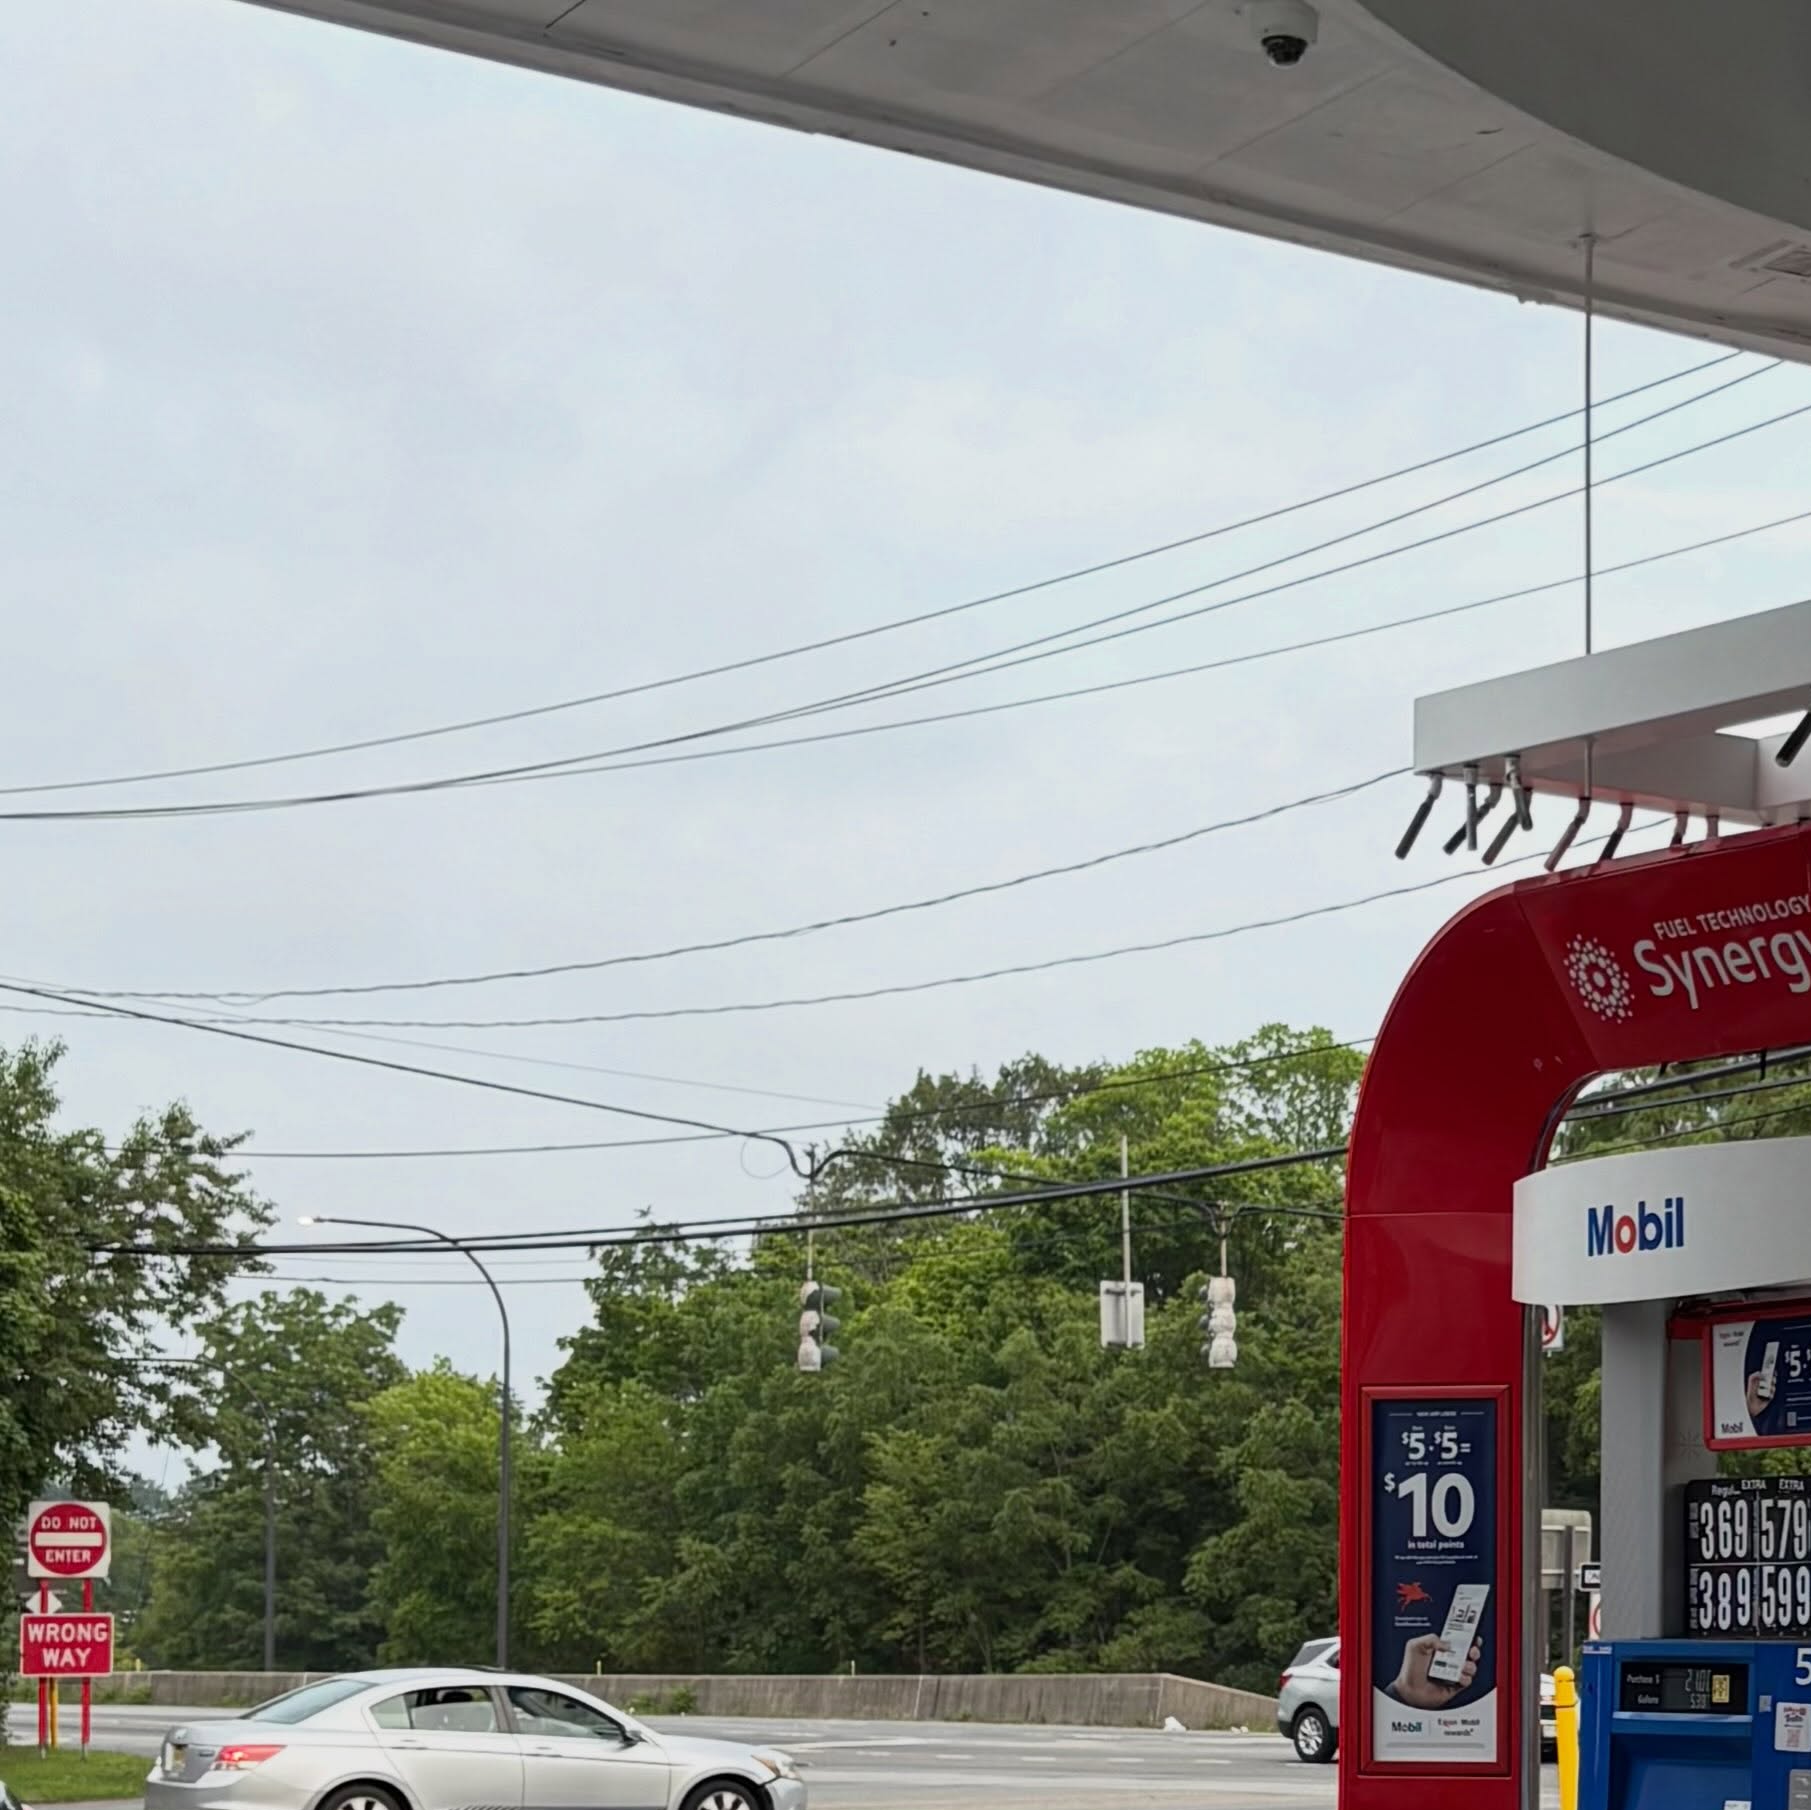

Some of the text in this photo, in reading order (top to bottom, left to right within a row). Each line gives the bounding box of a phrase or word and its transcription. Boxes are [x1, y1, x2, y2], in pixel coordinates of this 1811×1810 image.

[1654, 893, 1811, 940] FUEL TECHNOLOGY
[1587, 1197, 1685, 1257] Mobil
[1384, 1472, 1475, 1538] $10
[41, 1516, 97, 1529] DO NOT
[45, 1550, 91, 1563] ENTER
[28, 1623, 108, 1642] WRONG
[42, 1648, 91, 1667] WAY
[1392, 1721, 1422, 1732] Mobil
